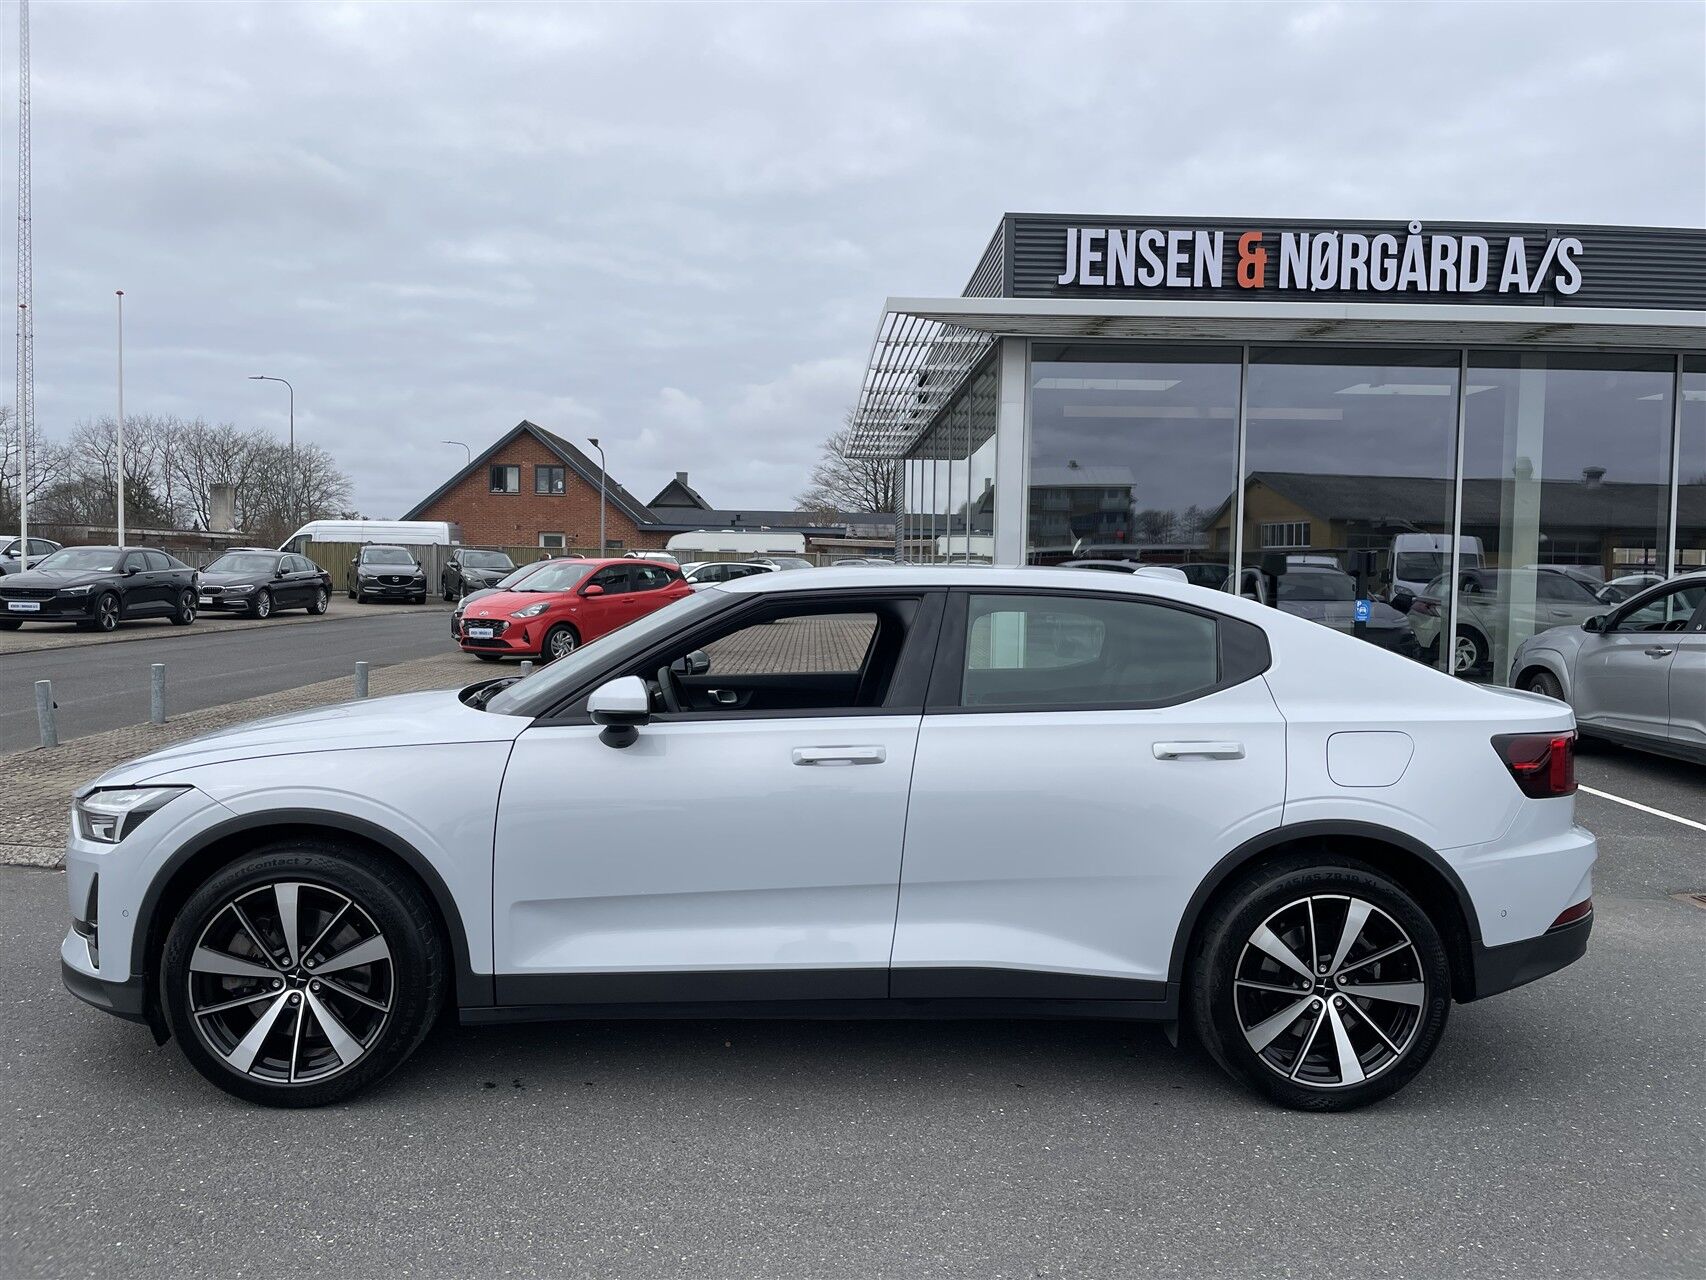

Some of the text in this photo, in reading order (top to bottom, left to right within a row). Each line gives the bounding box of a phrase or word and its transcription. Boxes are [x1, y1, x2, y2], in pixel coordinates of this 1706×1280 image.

[1058, 220, 1583, 295] JENSEN & NØRGÅRD A/S
[212, 857, 313, 889] SportContact 7
